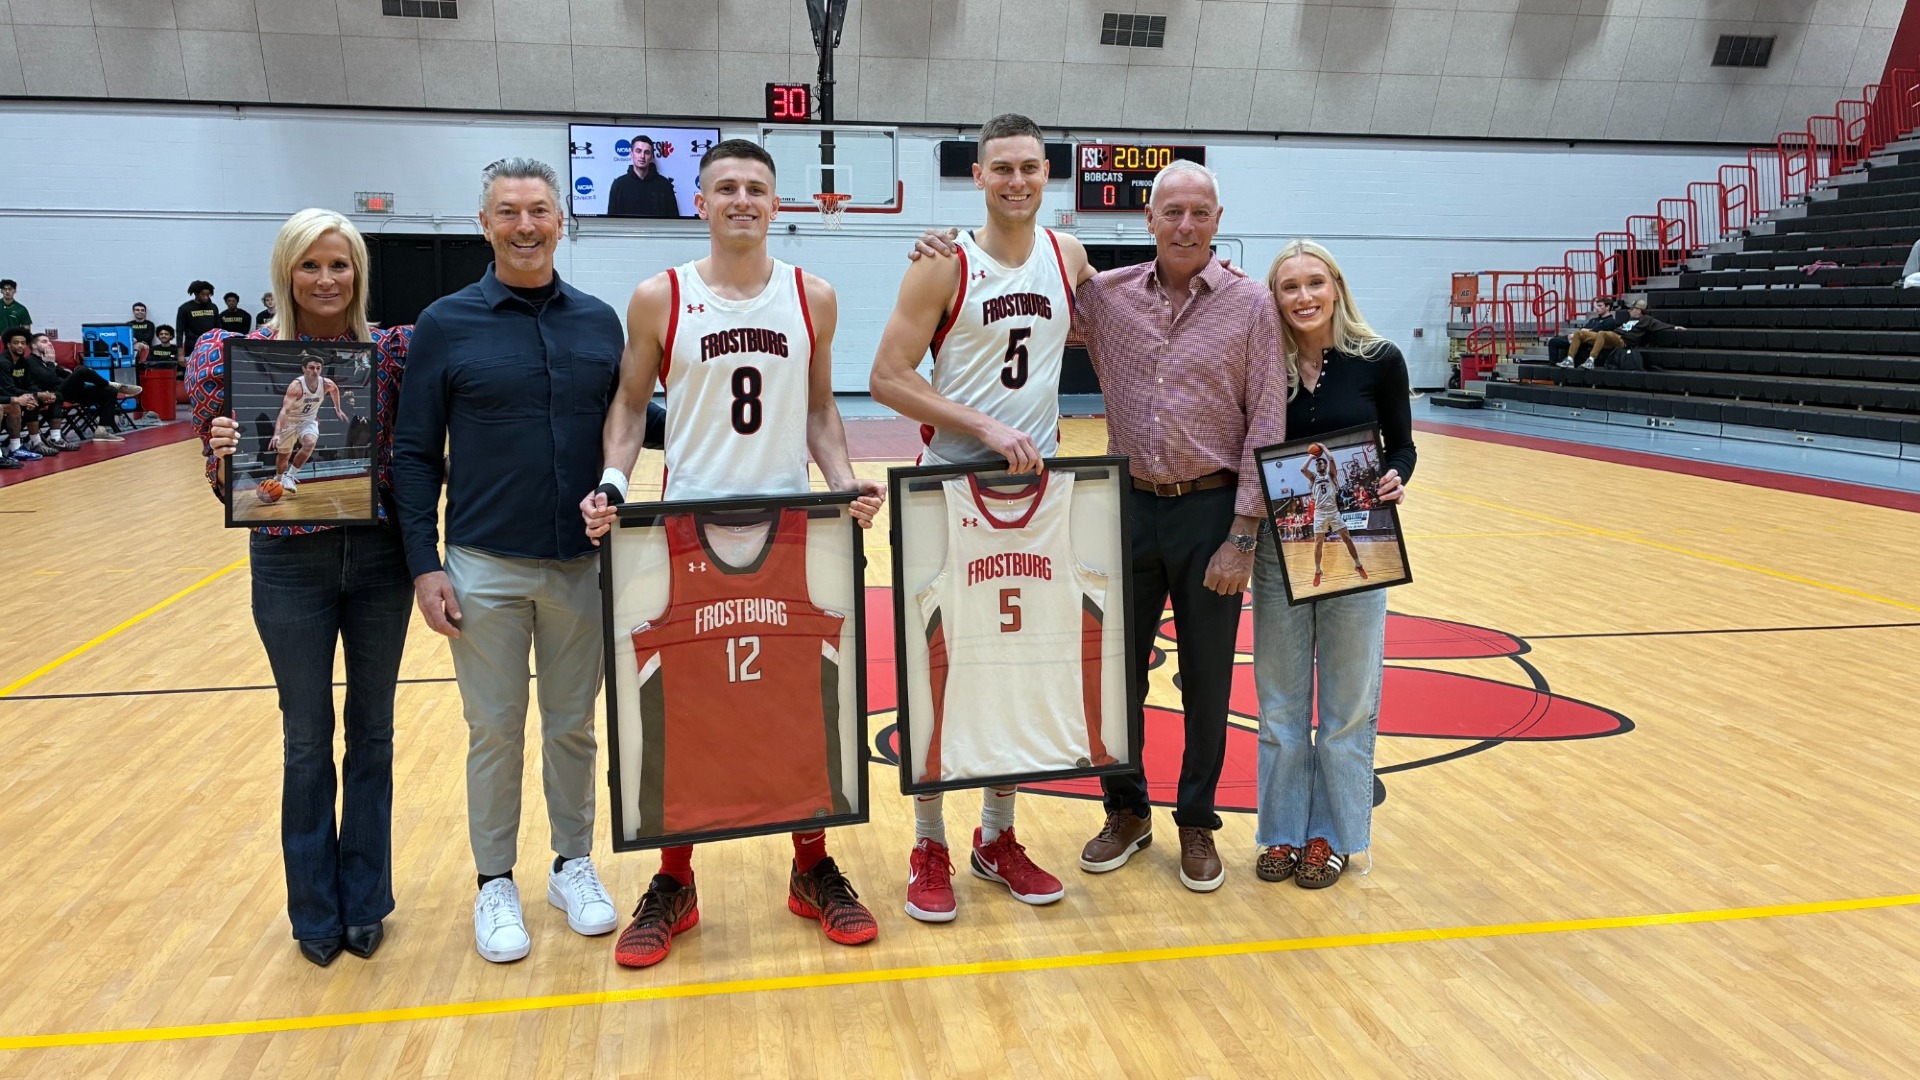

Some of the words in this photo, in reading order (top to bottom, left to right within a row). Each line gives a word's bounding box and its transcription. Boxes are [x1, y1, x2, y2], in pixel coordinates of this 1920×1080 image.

[774, 88, 805, 117] 30
[1114, 147, 1171, 169] 20:00
[1084, 173, 1123, 182] BOBCATS
[1103, 185, 1115, 205] 0
[983, 293, 1052, 327] FROSTBURG
[701, 328, 788, 363] FROSTBURG
[1001, 326, 1031, 389] 5
[731, 366, 762, 435] 8
[968, 553, 1052, 587] FROSTBURG
[695, 598, 788, 635] FROSTBURG
[999, 588, 1021, 633] 5
[725, 635, 761, 683] 12
